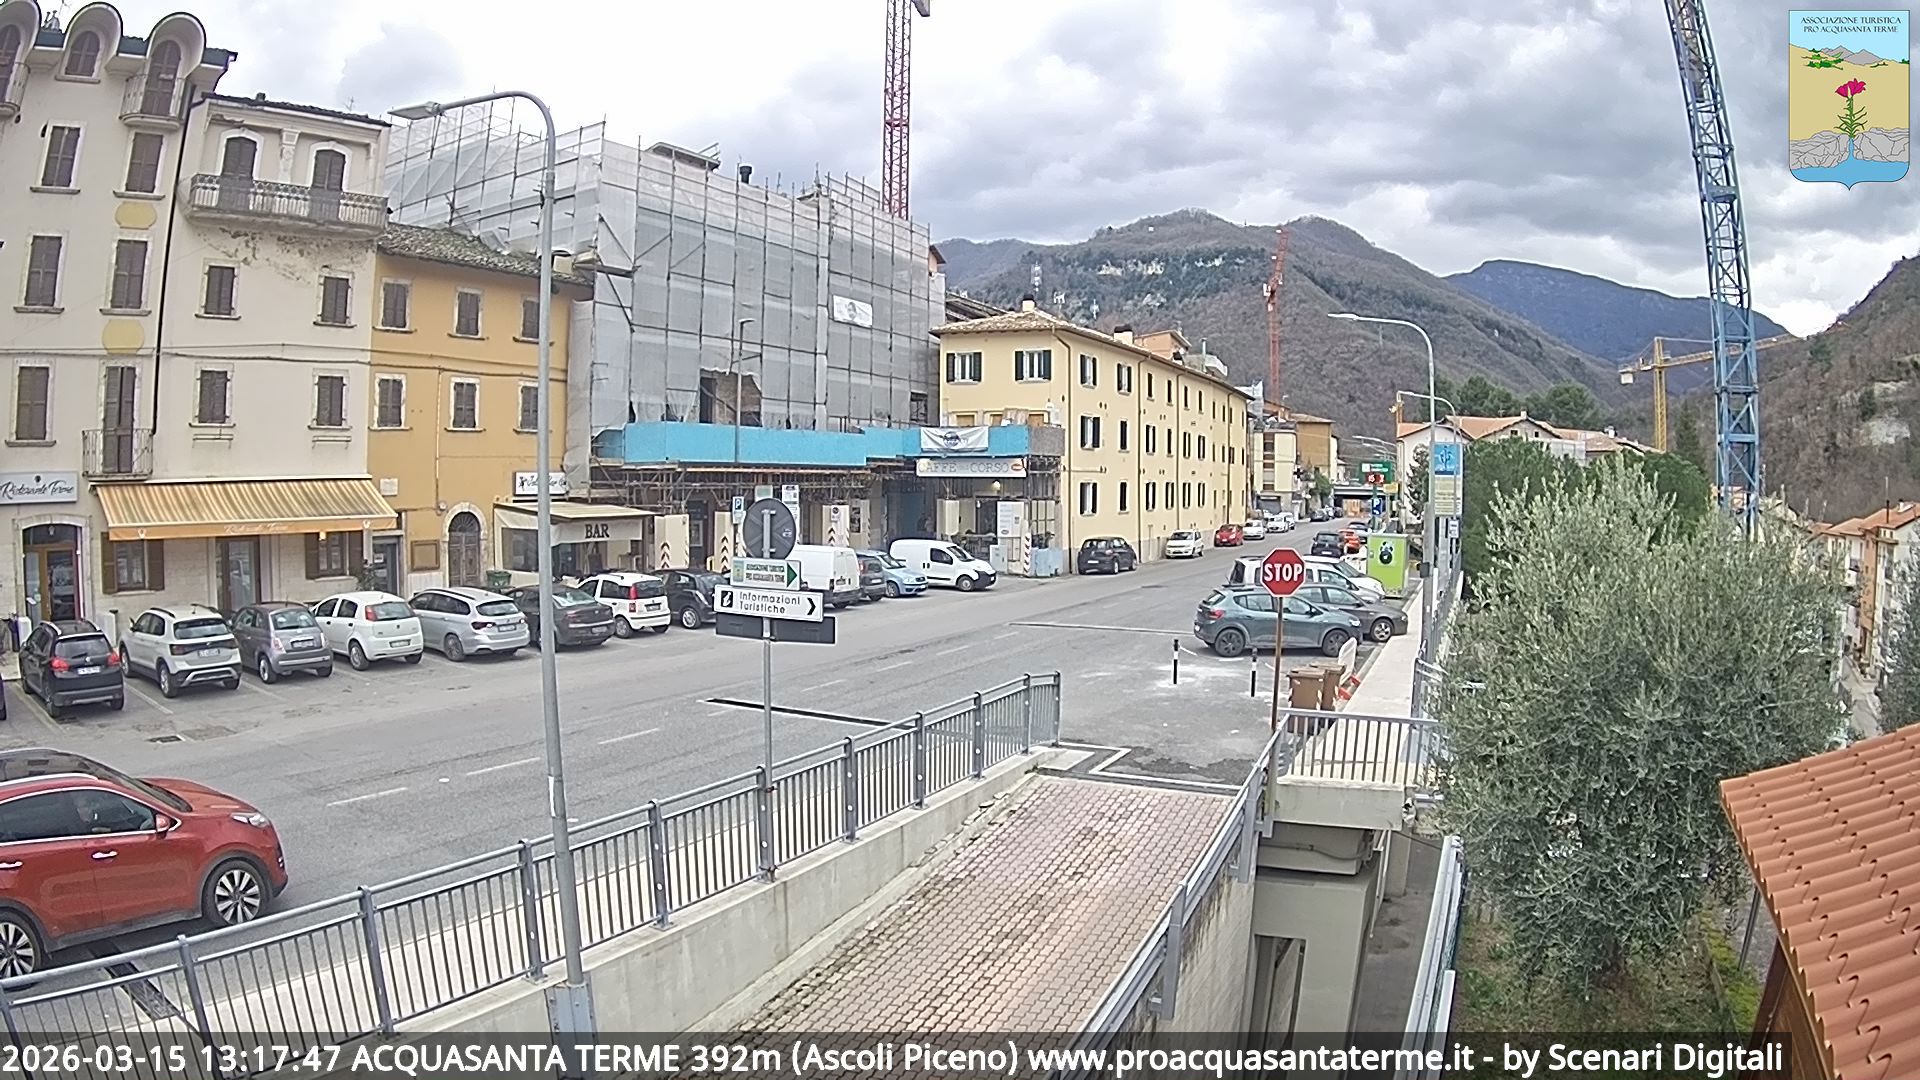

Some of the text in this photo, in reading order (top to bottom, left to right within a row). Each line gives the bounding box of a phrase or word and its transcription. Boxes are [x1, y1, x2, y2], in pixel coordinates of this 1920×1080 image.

[970, 462, 1009, 473] CORSO
[585, 523, 610, 539] BAR
[1264, 563, 1303, 582] STOP
[740, 591, 801, 605] Informazioni
[740, 600, 786, 614] Turistiche
